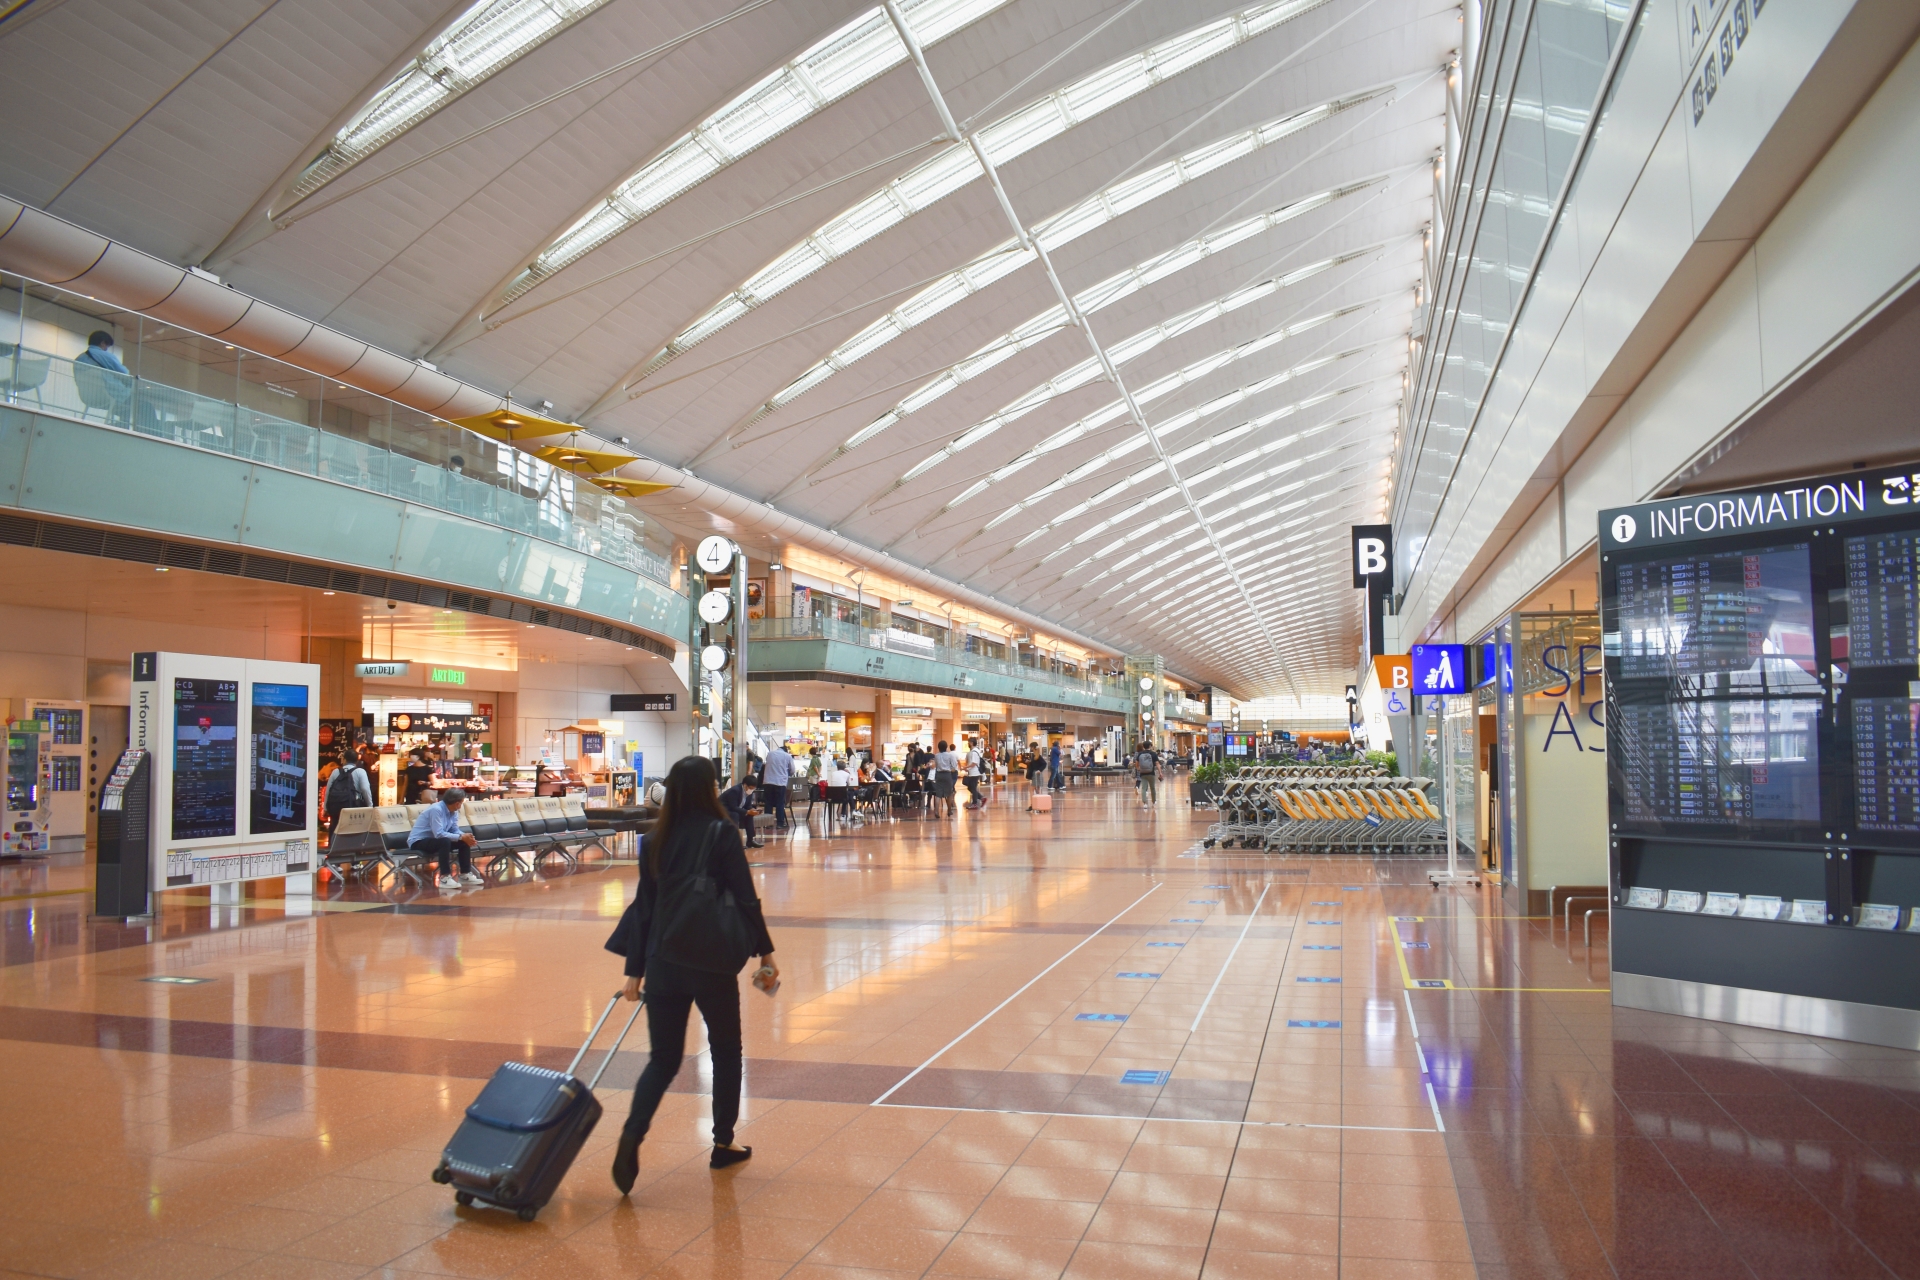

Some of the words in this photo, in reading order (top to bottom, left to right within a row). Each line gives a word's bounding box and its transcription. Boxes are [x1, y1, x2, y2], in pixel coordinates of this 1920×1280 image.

[1651, 480, 1865, 539] INFORMATION
[706, 542, 720, 566] 4
[1359, 538, 1387, 575] B
[1850, 570, 1867, 578] 17:00
[1416, 646, 1424, 656] 9
[364, 665, 377, 675] ART
[432, 667, 447, 682] ART
[1392, 666, 1409, 689] B
[1346, 687, 1357, 699] A
